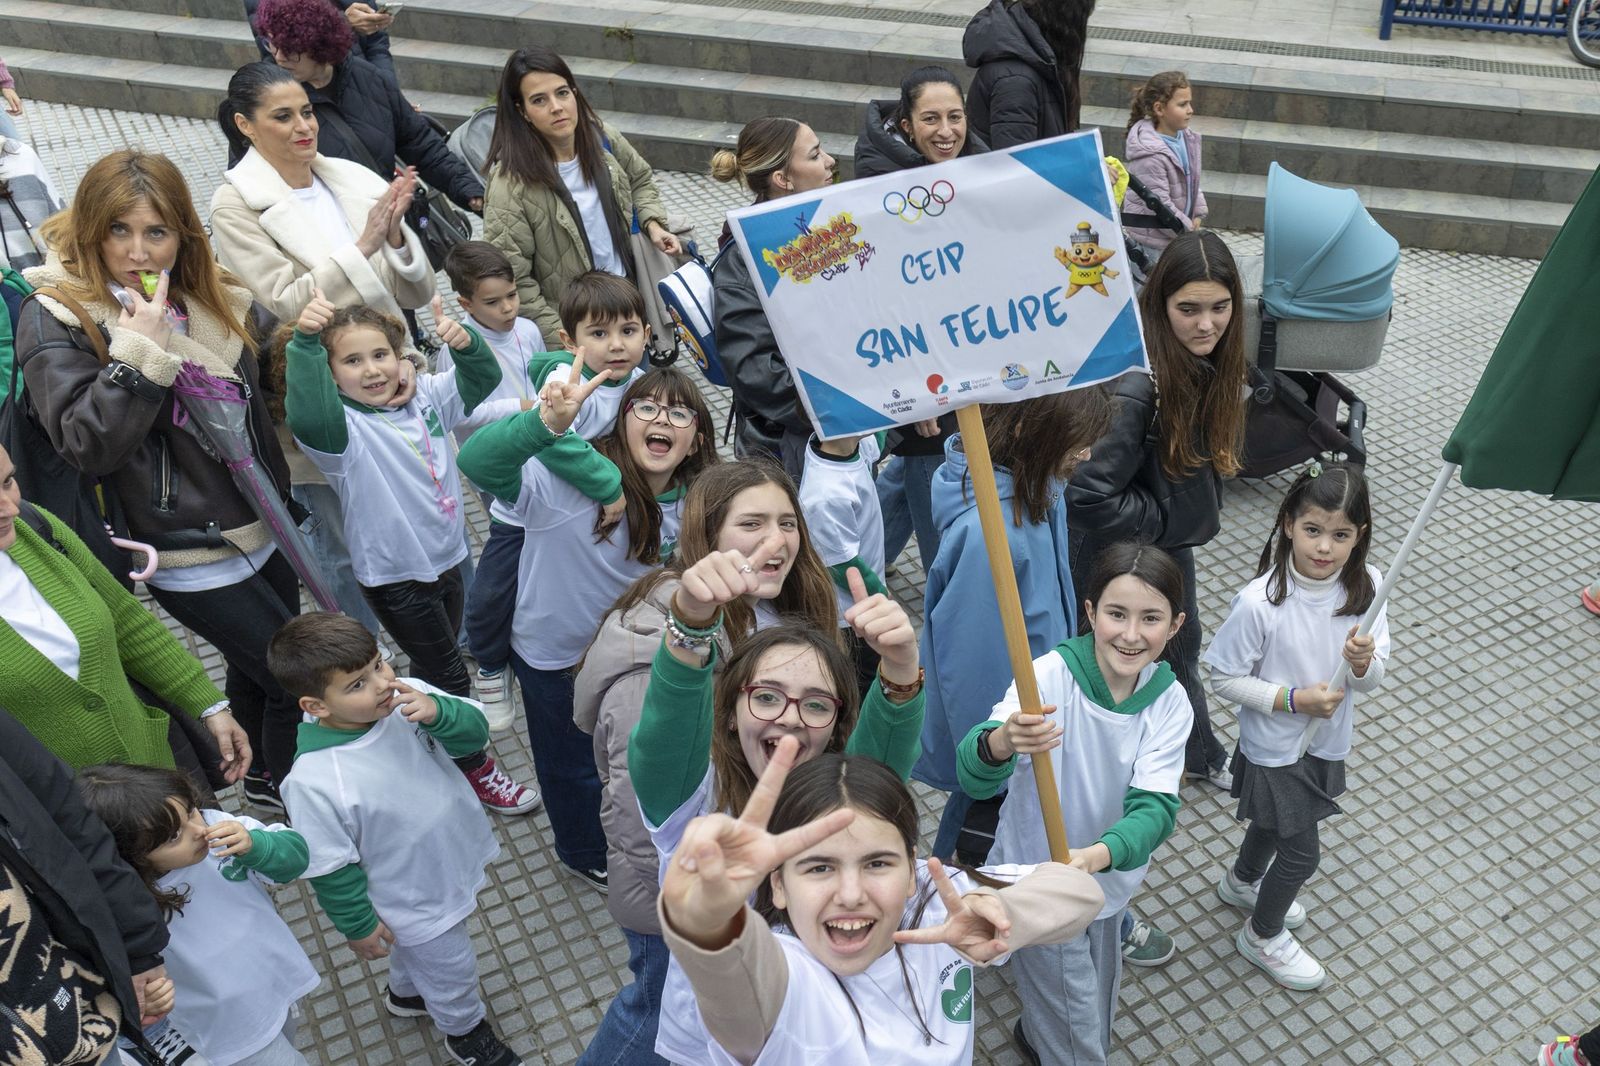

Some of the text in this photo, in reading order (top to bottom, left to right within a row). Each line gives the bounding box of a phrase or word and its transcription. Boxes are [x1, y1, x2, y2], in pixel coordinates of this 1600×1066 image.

[901, 241, 964, 284] CEIP
[856, 286, 1067, 368] SAN FELIPE
[951, 1002, 963, 1016] SAN
